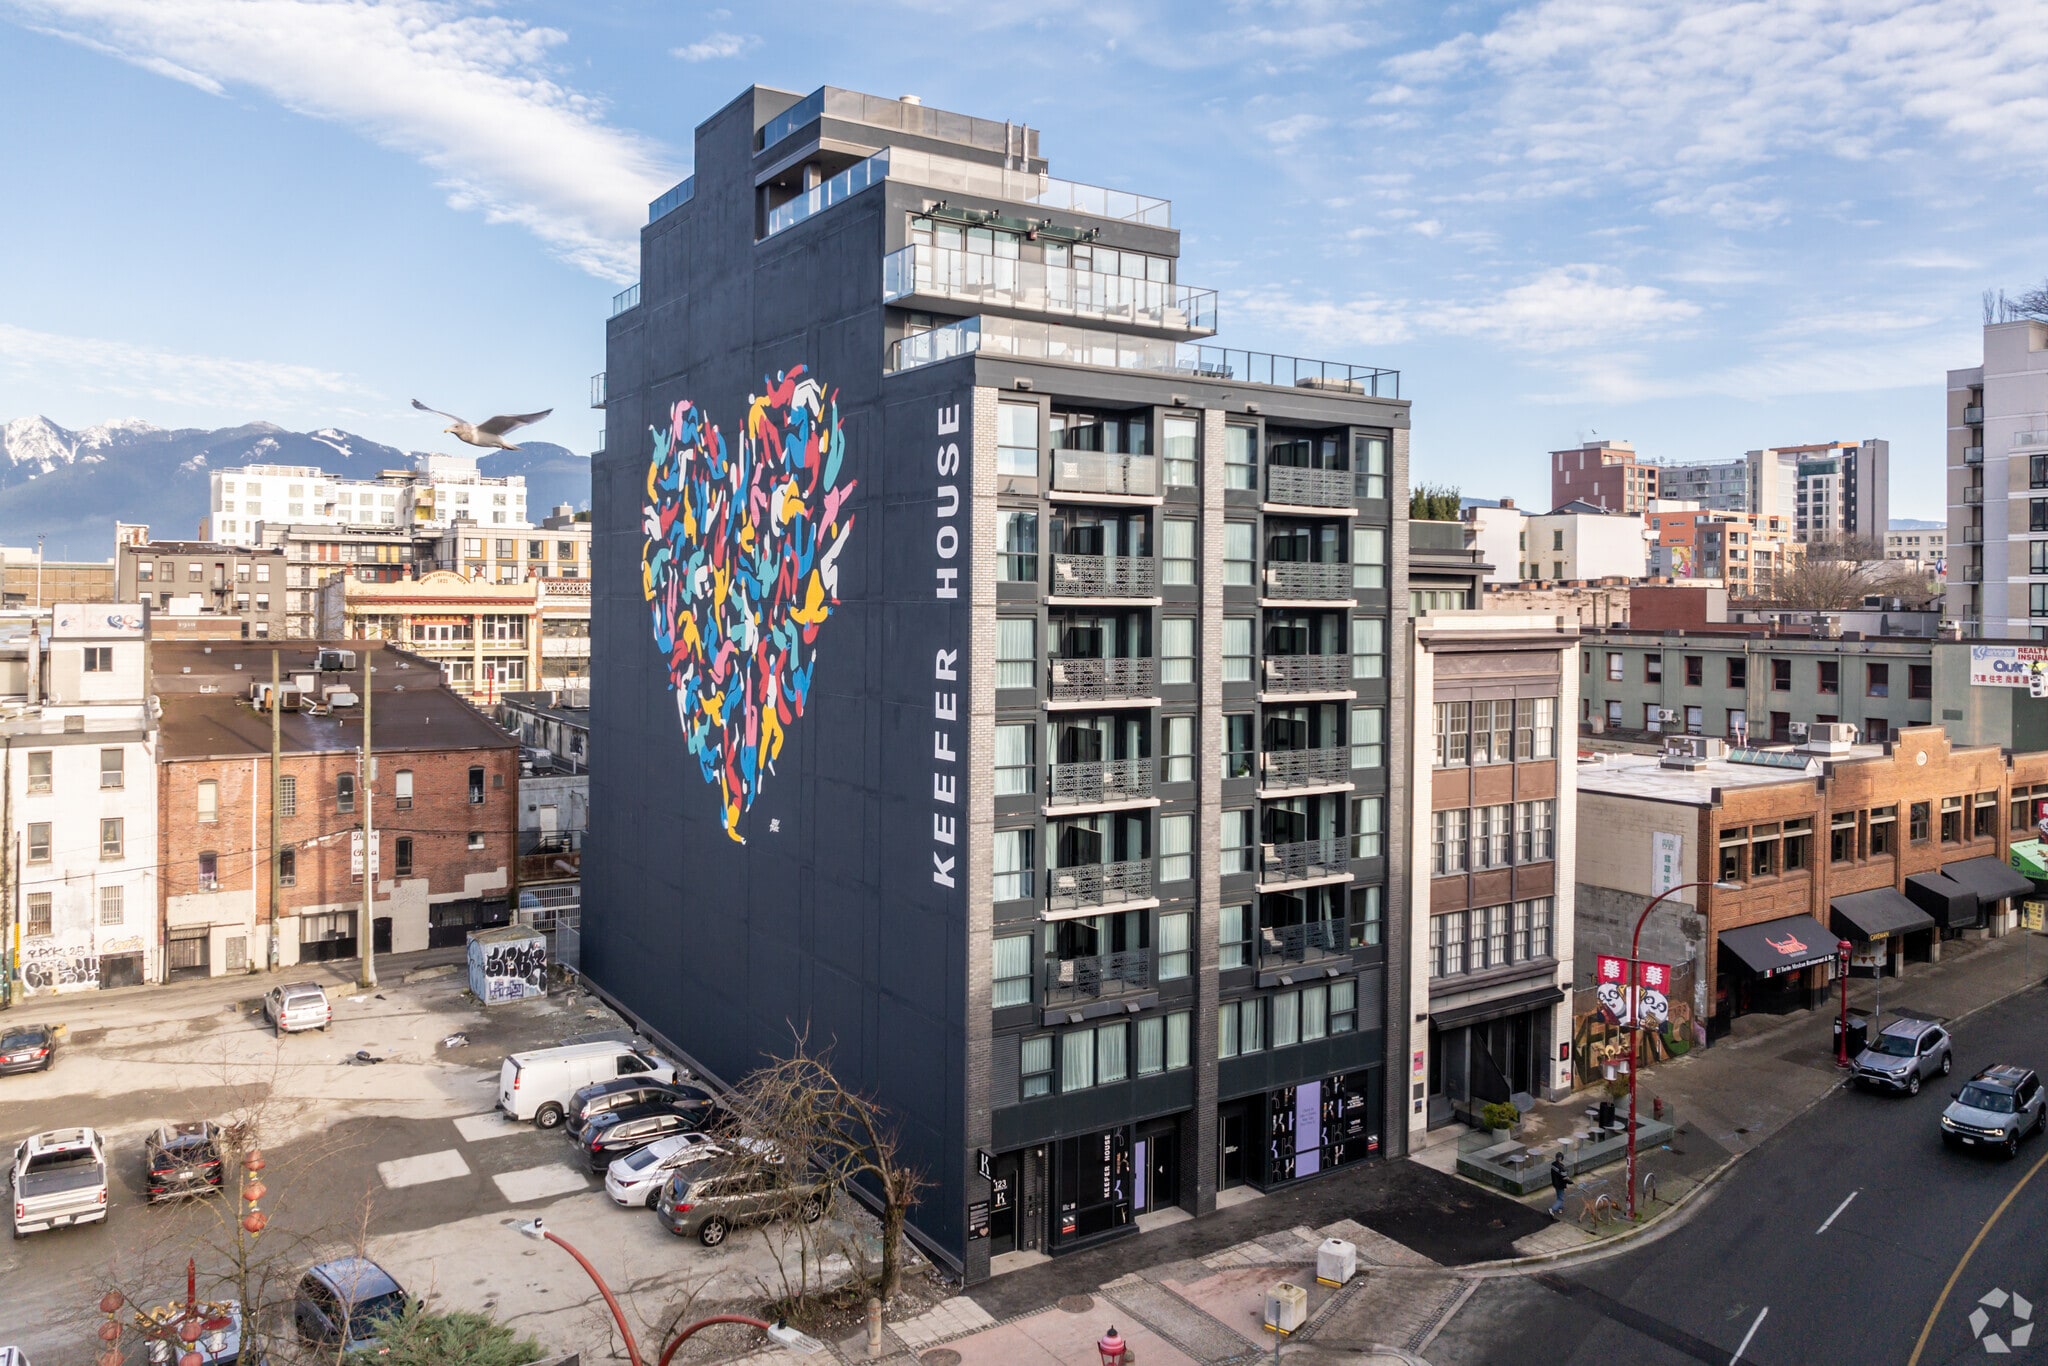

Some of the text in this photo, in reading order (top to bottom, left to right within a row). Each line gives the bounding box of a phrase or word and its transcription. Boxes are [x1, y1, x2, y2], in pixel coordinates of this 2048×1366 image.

[932, 402, 960, 889] KEEFER HOUSE
[2017, 647, 2047, 655] REALTY
[1603, 959, 1621, 979] 華
[1645, 965, 1663, 985] 華
[981, 1153, 990, 1175] K
[994, 1179, 1007, 1189] 123
[997, 1192, 1005, 1204] K
